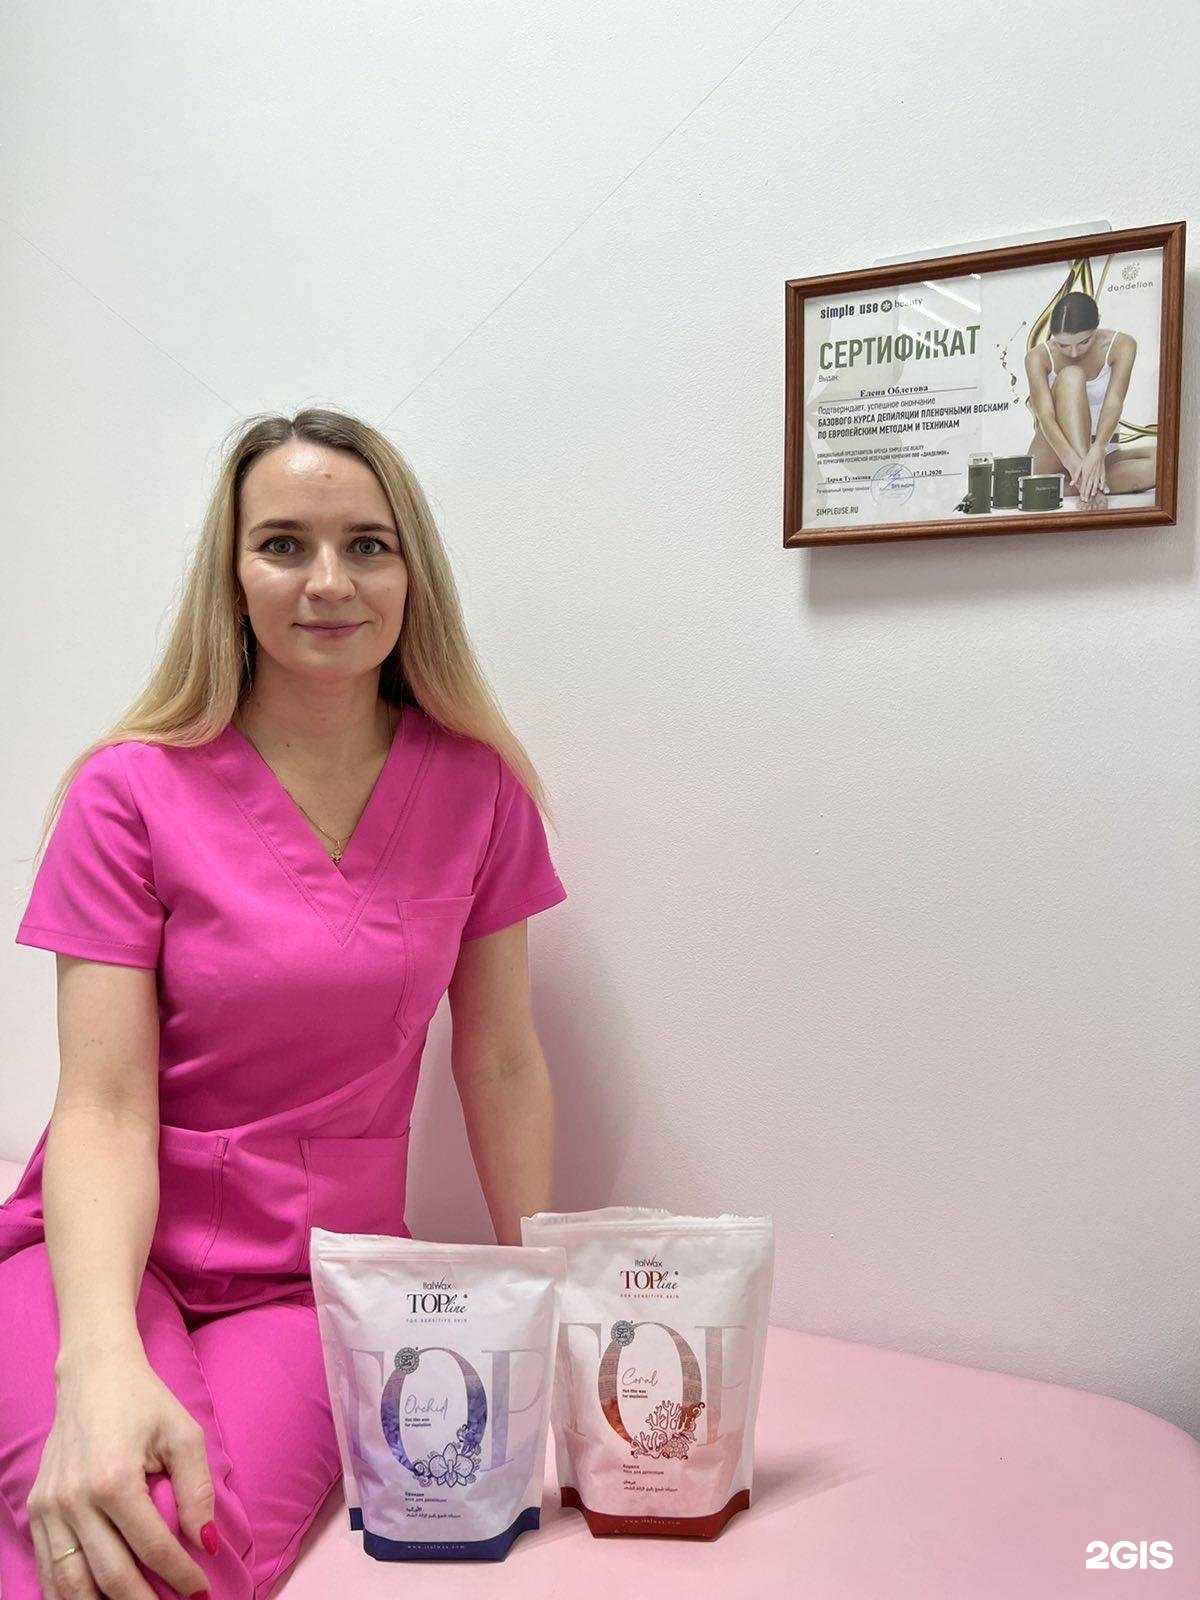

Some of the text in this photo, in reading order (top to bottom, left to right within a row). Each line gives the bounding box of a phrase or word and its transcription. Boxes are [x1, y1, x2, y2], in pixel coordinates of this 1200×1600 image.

[1107, 282, 1154, 292] dandelion
[820, 304, 855, 319] simple
[859, 303, 878, 315] use
[819, 325, 981, 370] СЕРТИФИКАТ
[860, 389, 886, 397] Елена
[900, 398, 936, 408] окончание
[818, 402, 1009, 428] БАЗОВОГО КУРСА ДЕПИЛЯЦИИ ПЛЕНОЧНЫМИ ВОСКАМИ
[817, 419, 960, 440] ПО ЕВРОПЕЙСКИМ МЕТОДАМ И ТЕХНИКАМ
[816, 506, 859, 516] SIMPLEUSE.RU
[622, 1367, 658, 1387] Coral
[404, 1394, 449, 1420] Orchid
